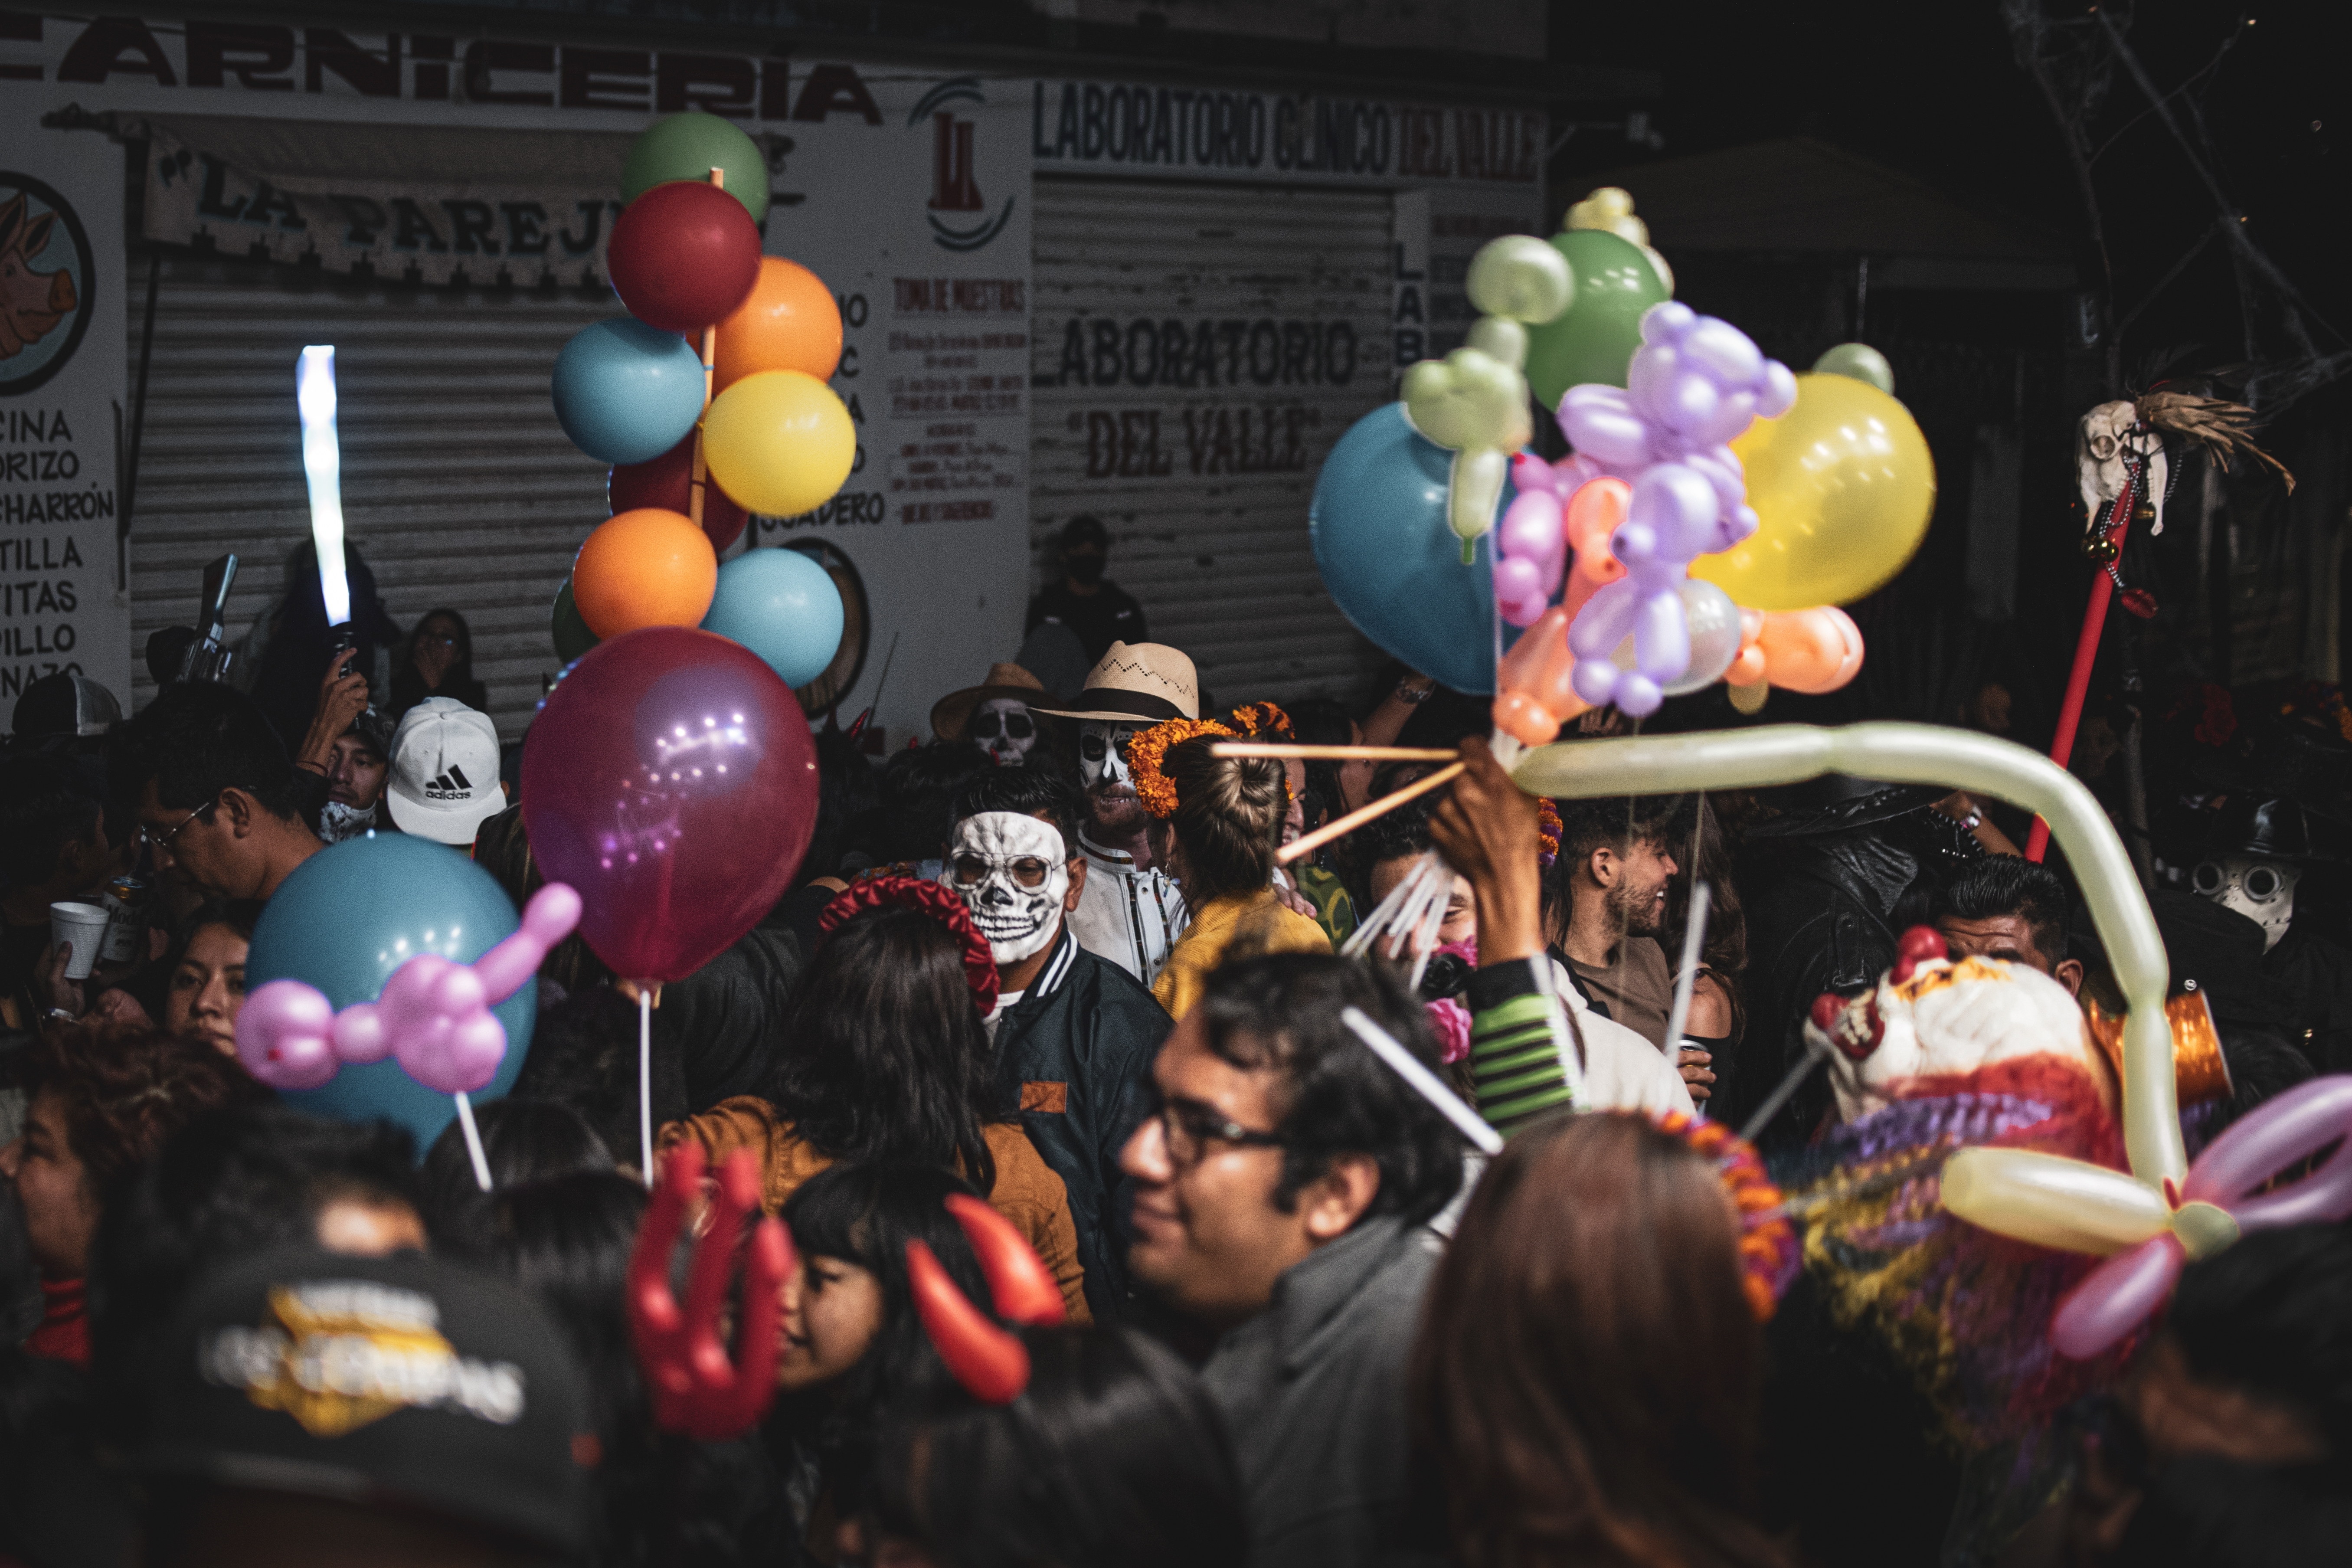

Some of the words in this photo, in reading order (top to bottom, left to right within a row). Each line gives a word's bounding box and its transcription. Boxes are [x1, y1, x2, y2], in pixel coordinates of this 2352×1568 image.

[1032, 80, 1266, 168] LABORATORIO
[0, 449, 81, 482] RIZO
[0, 481, 114, 525] HARRÓN
[0, 579, 78, 618] ITAS
[0, 623, 76, 657] ILLO
[425, 789, 471, 801] adidas
